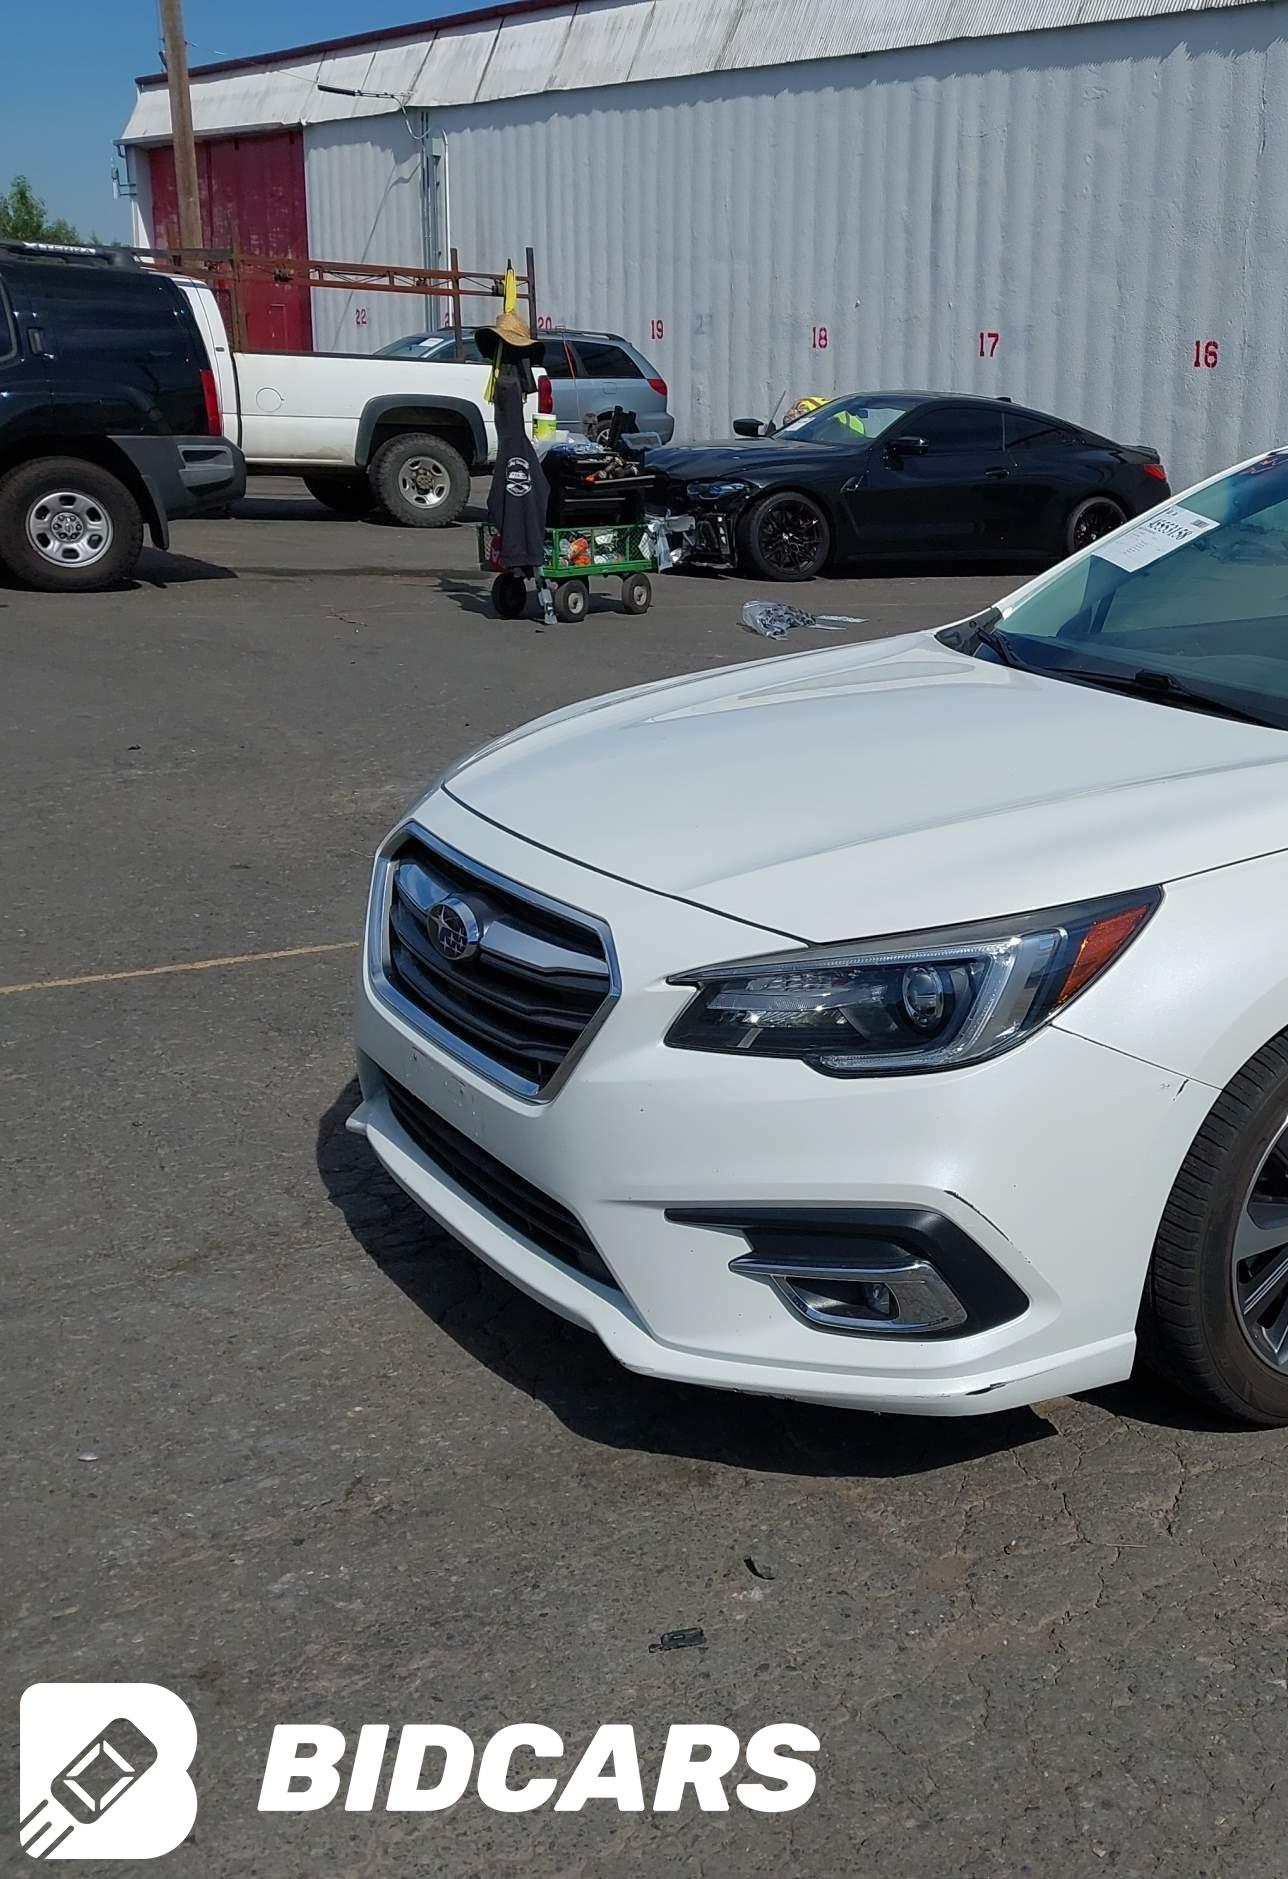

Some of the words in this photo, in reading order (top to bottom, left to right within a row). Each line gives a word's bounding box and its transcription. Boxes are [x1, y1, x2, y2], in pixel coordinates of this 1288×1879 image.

[355, 308, 367, 325] 22
[651, 319, 664, 340] 19
[812, 327, 828, 348] 18
[978, 332, 1000, 357] 17
[1193, 340, 1219, 368] 16
